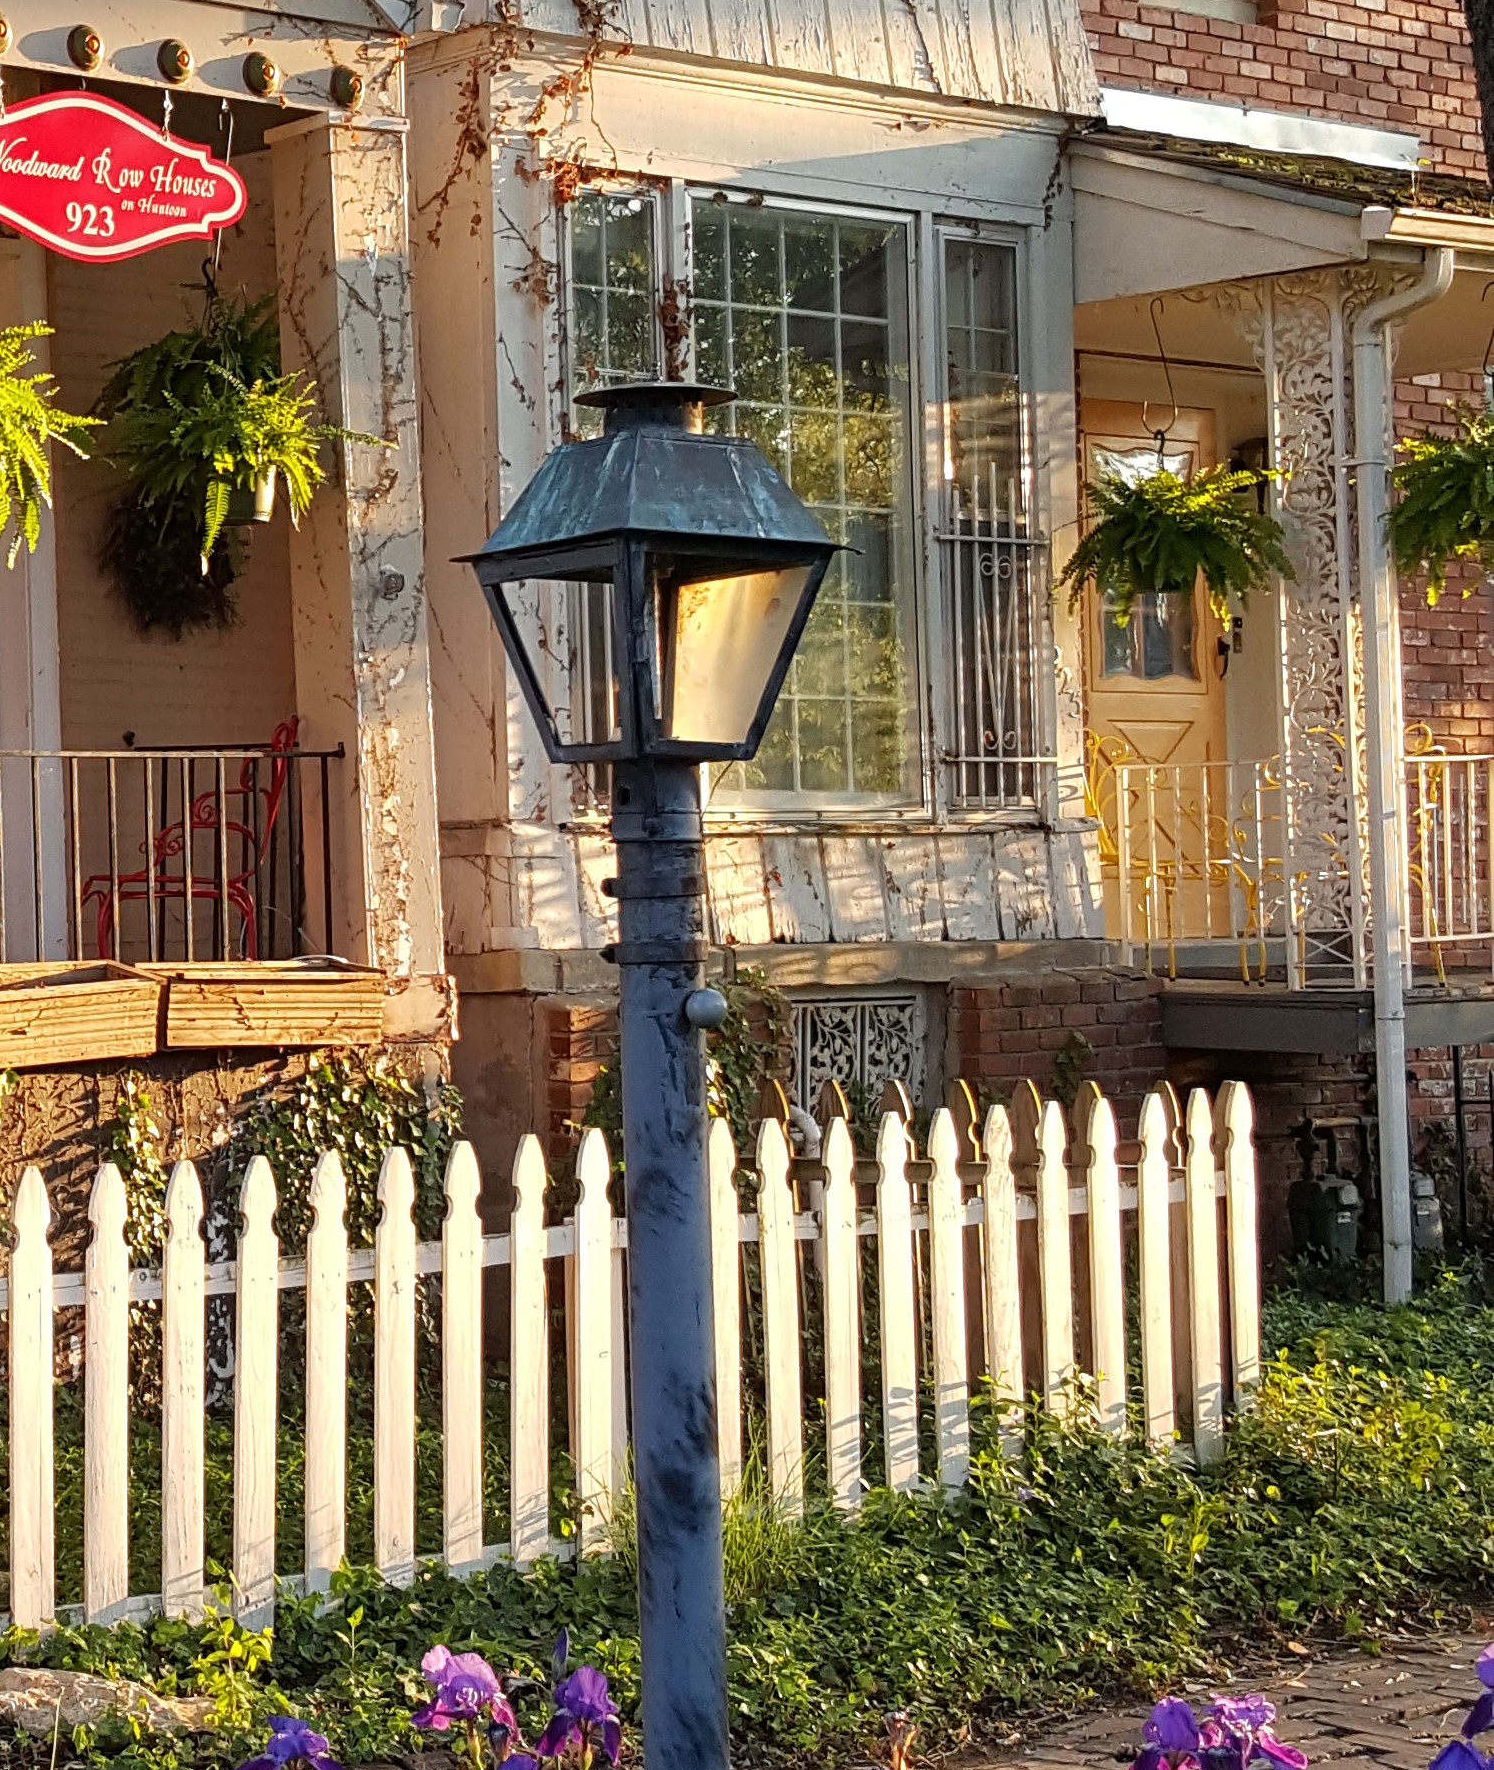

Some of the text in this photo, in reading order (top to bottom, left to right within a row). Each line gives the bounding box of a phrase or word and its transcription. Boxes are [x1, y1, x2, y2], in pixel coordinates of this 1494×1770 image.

[150, 157, 217, 198] Houses
[66, 201, 116, 238] 923
[121, 194, 188, 218] on Huntoon
